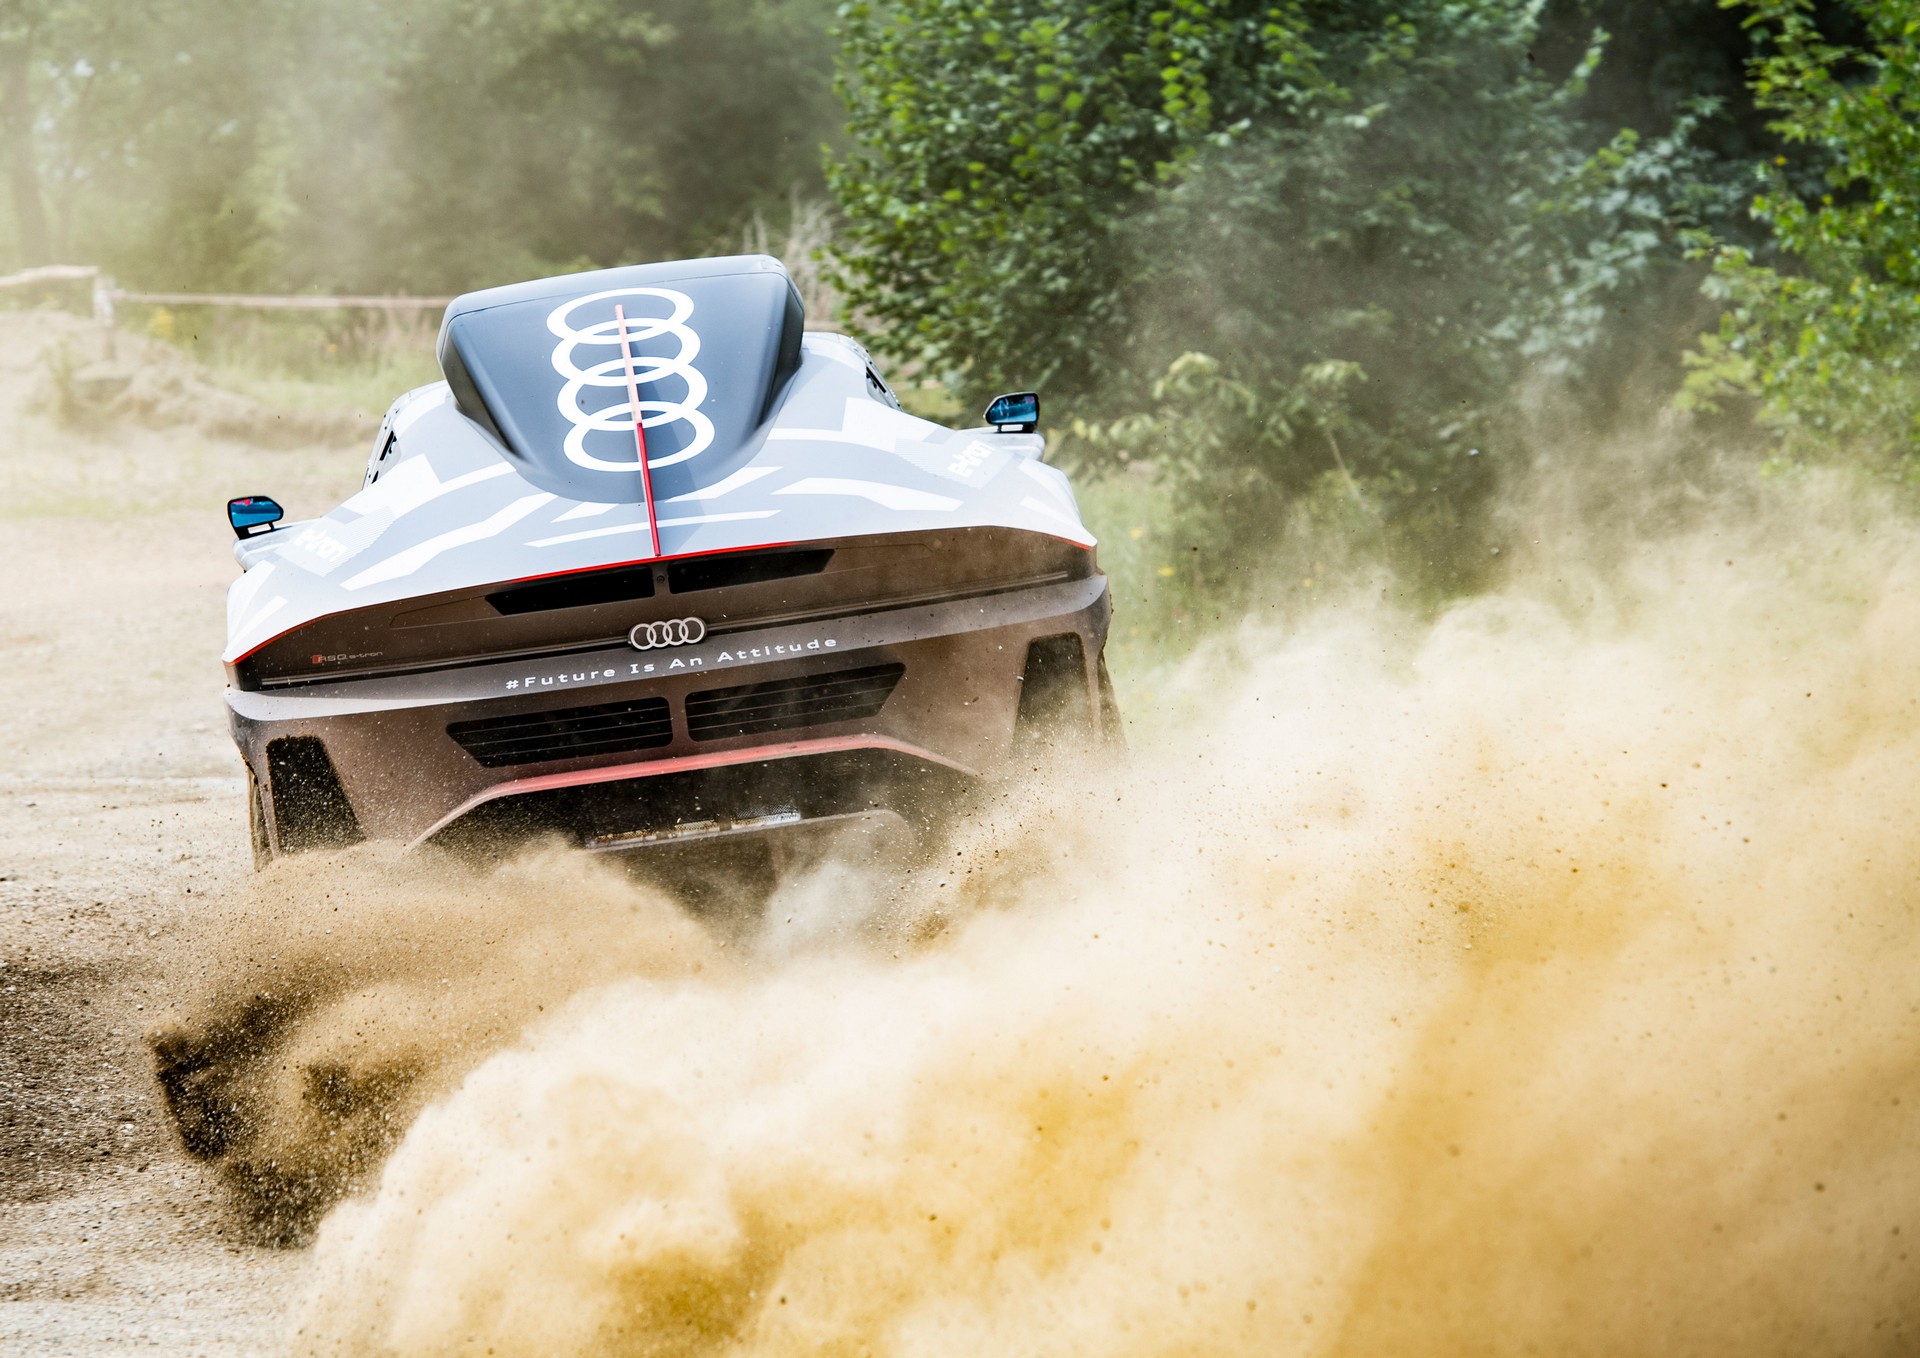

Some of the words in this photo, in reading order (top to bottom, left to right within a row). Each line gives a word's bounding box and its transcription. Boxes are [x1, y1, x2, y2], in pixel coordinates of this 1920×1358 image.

[349, 651, 383, 660] e-tron
[505, 669, 616, 690] #Future
[630, 663, 655, 675] Is
[669, 656, 703, 669] An
[717, 639, 837, 663] Attitude
